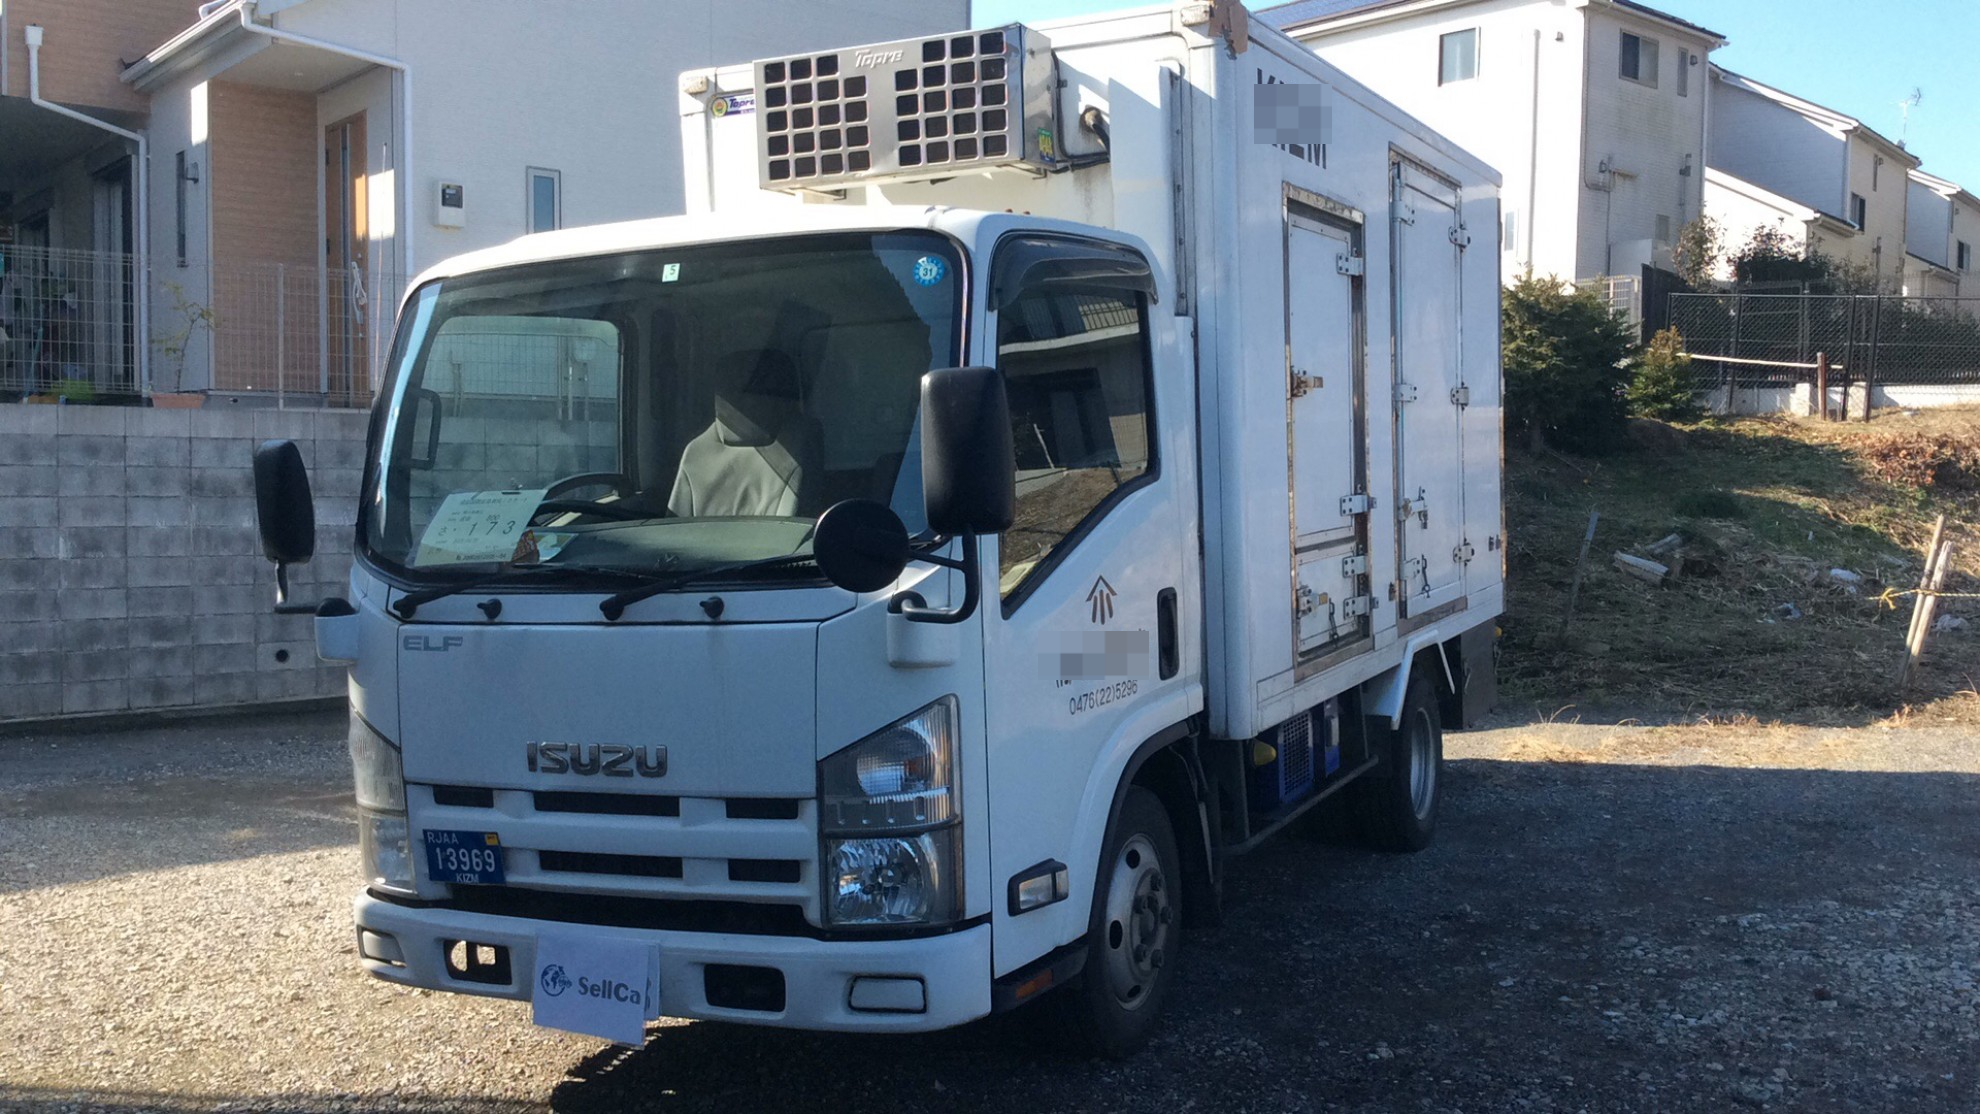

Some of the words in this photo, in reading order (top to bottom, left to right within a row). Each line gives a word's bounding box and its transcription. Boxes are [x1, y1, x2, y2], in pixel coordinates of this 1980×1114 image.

[855, 49, 903, 68] Topre
[669, 264, 677, 276] 5
[922, 267, 933, 277] 31
[403, 635, 464, 652] ELF
[1069, 679, 1138, 715] 0476(22)5296
[527, 741, 668, 778] ISUZU
[427, 831, 459, 845] RJAA
[436, 847, 496, 873] 13969
[456, 873, 480, 884] KIZM
[578, 976, 641, 1006] SellCa
